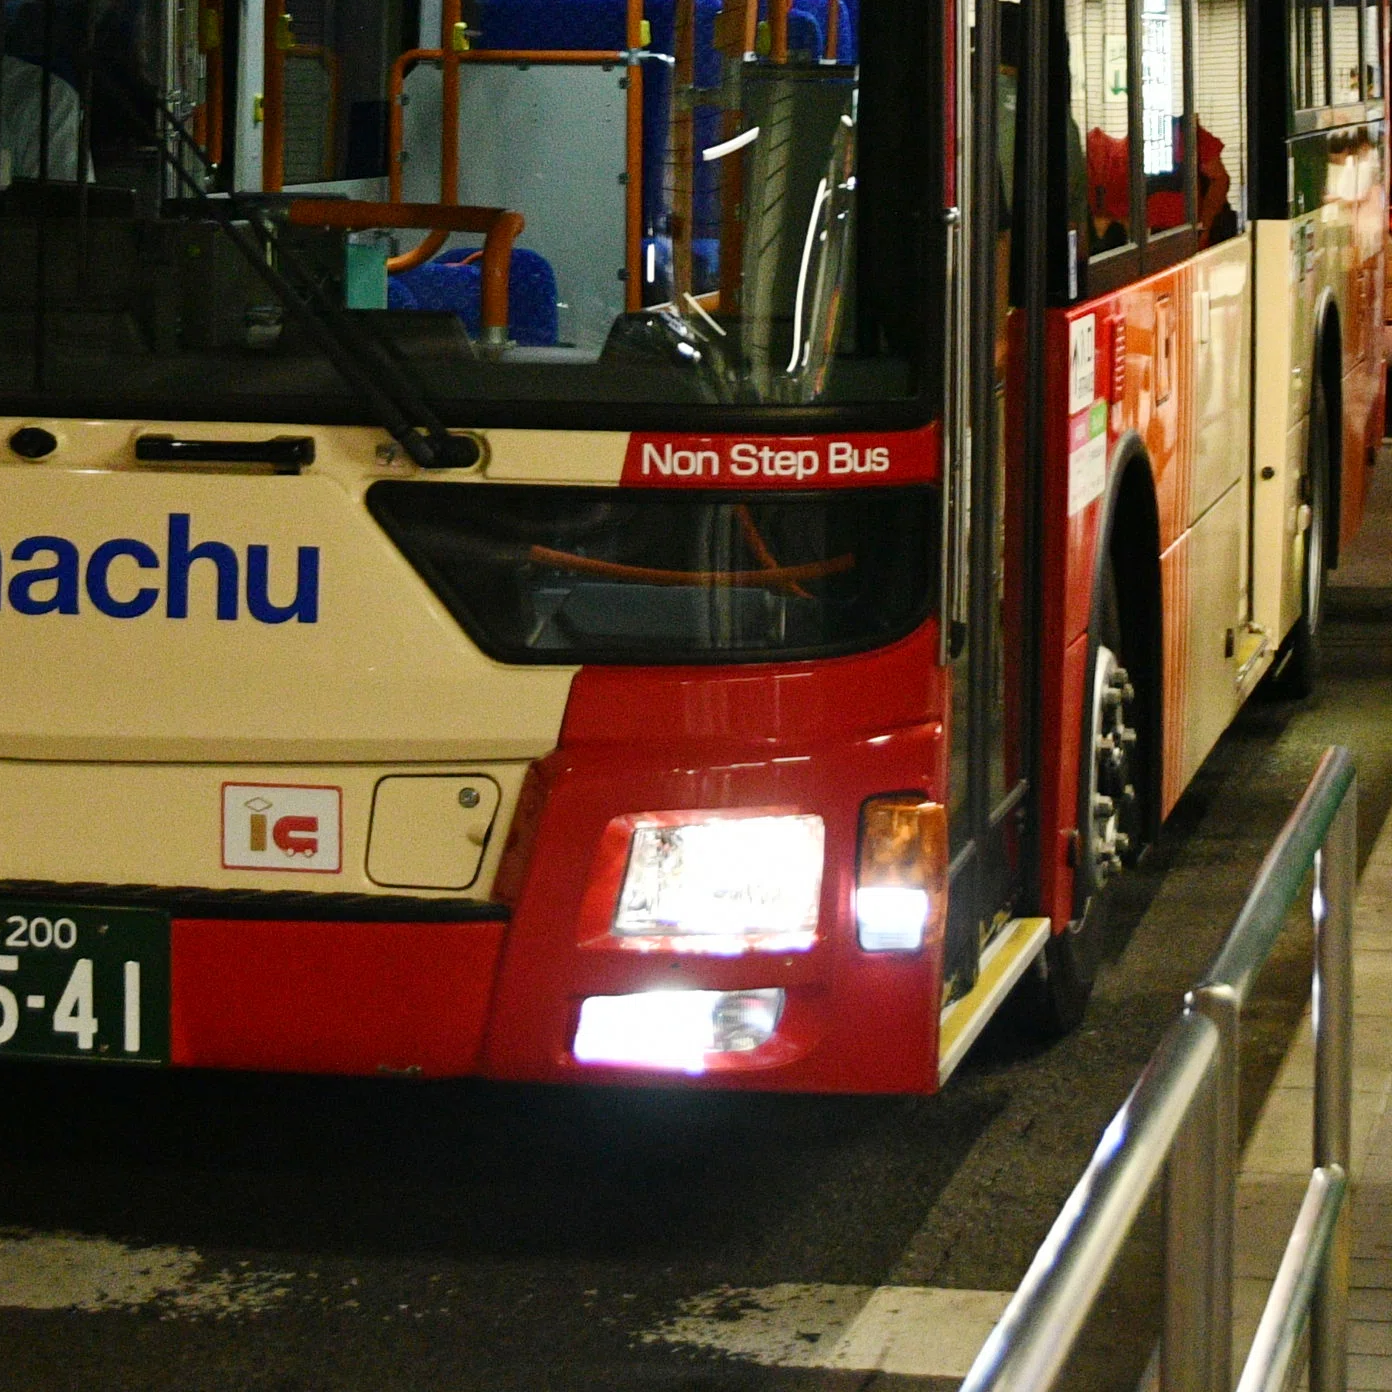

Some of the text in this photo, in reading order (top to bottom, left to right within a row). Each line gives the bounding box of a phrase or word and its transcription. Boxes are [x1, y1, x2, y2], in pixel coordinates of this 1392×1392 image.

[641, 441, 891, 481] Non Step Bus
